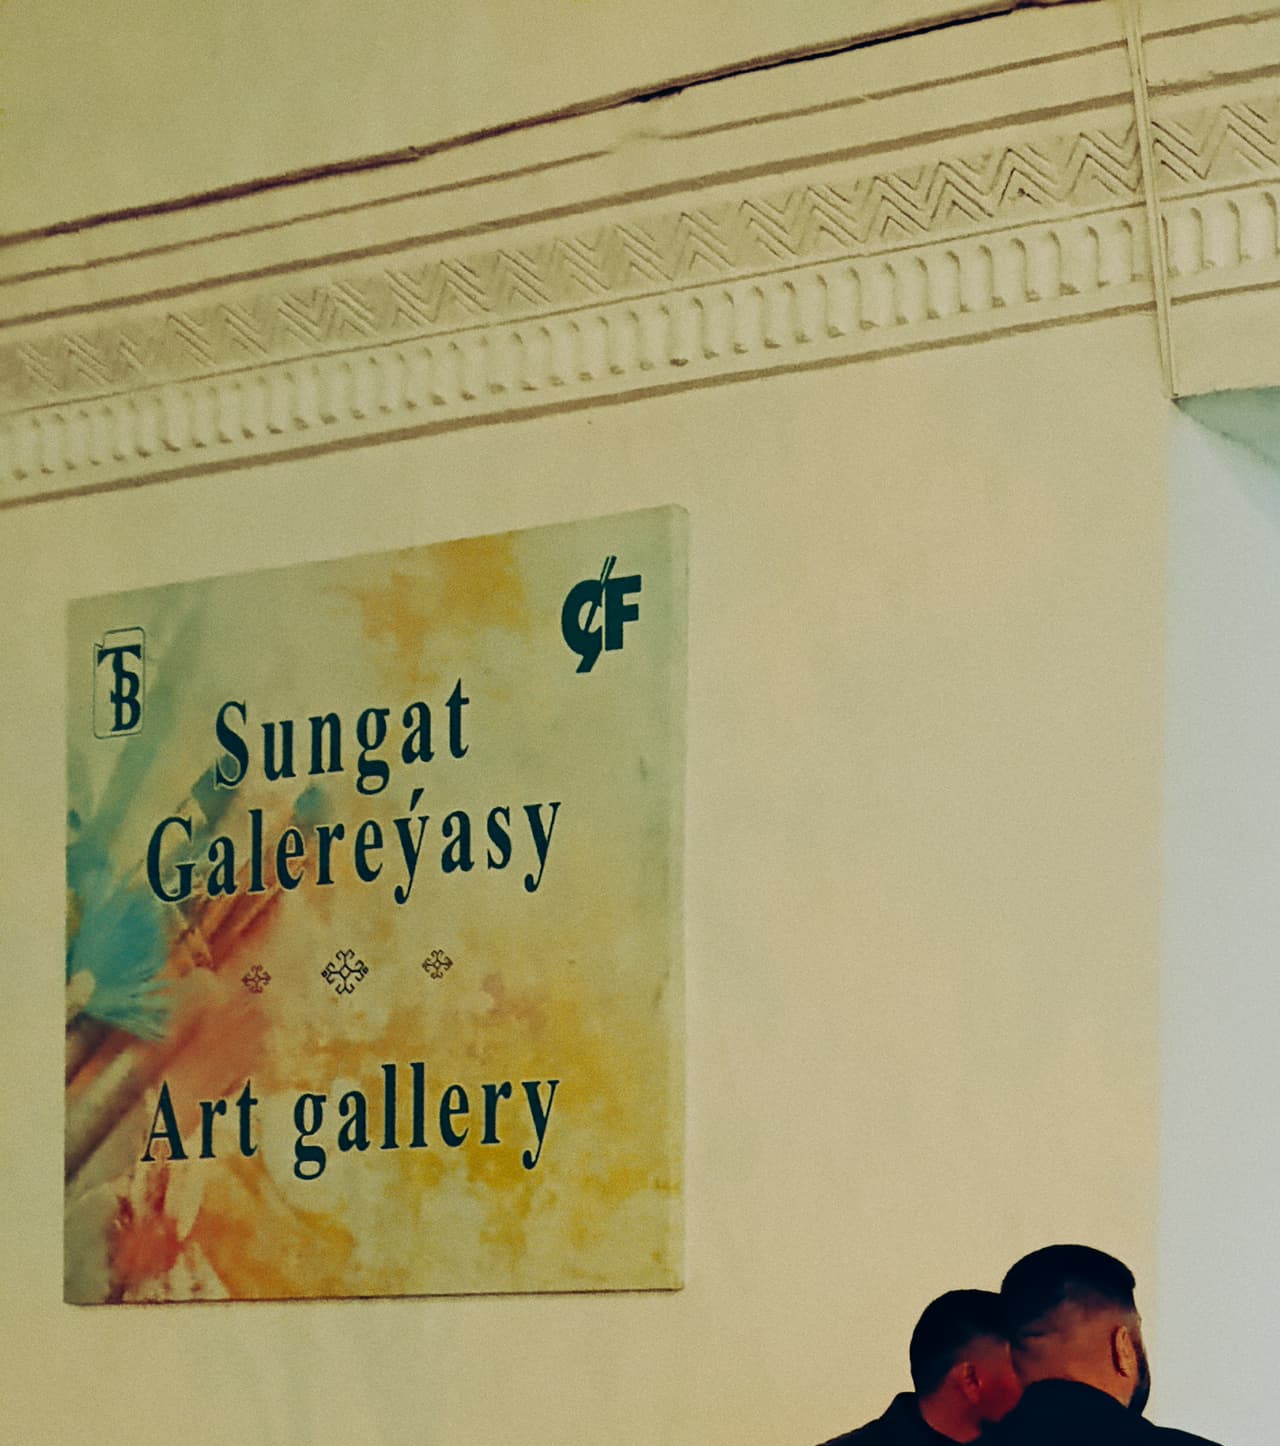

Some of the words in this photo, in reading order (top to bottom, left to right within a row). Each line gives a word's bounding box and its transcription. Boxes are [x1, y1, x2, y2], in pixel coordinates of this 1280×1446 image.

[213, 678, 471, 796] Sungat
[146, 788, 562, 905] Galereýasy
[140, 1078, 260, 1163] Art
[292, 1061, 561, 1181] gallery
